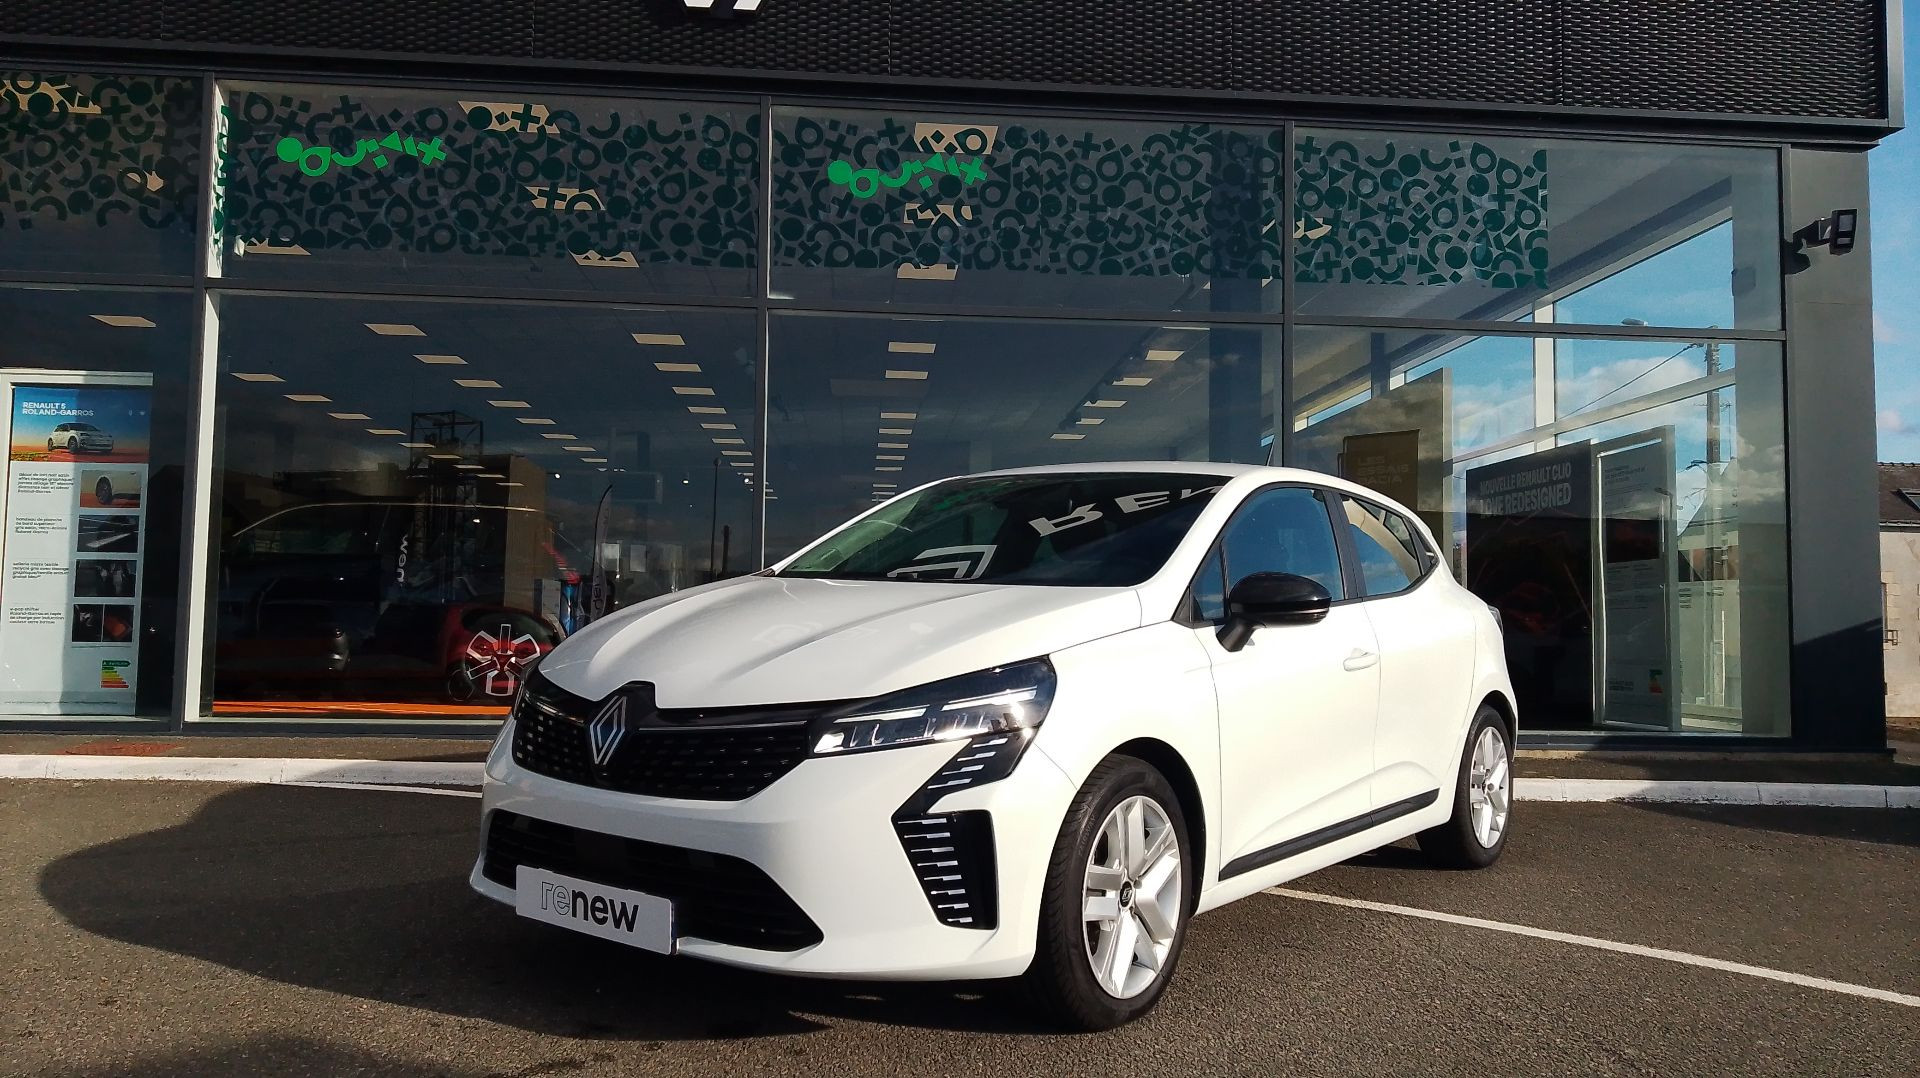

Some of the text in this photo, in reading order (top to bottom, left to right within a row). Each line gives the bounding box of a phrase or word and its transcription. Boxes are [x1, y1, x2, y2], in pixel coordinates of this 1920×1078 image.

[22, 408, 95, 416] ROLAND-GARROS
[1516, 466, 1551, 488] RENAULT
[1551, 462, 1571, 480] CLIO
[1504, 483, 1571, 515] REDESIGNED
[541, 881, 640, 933] renew
